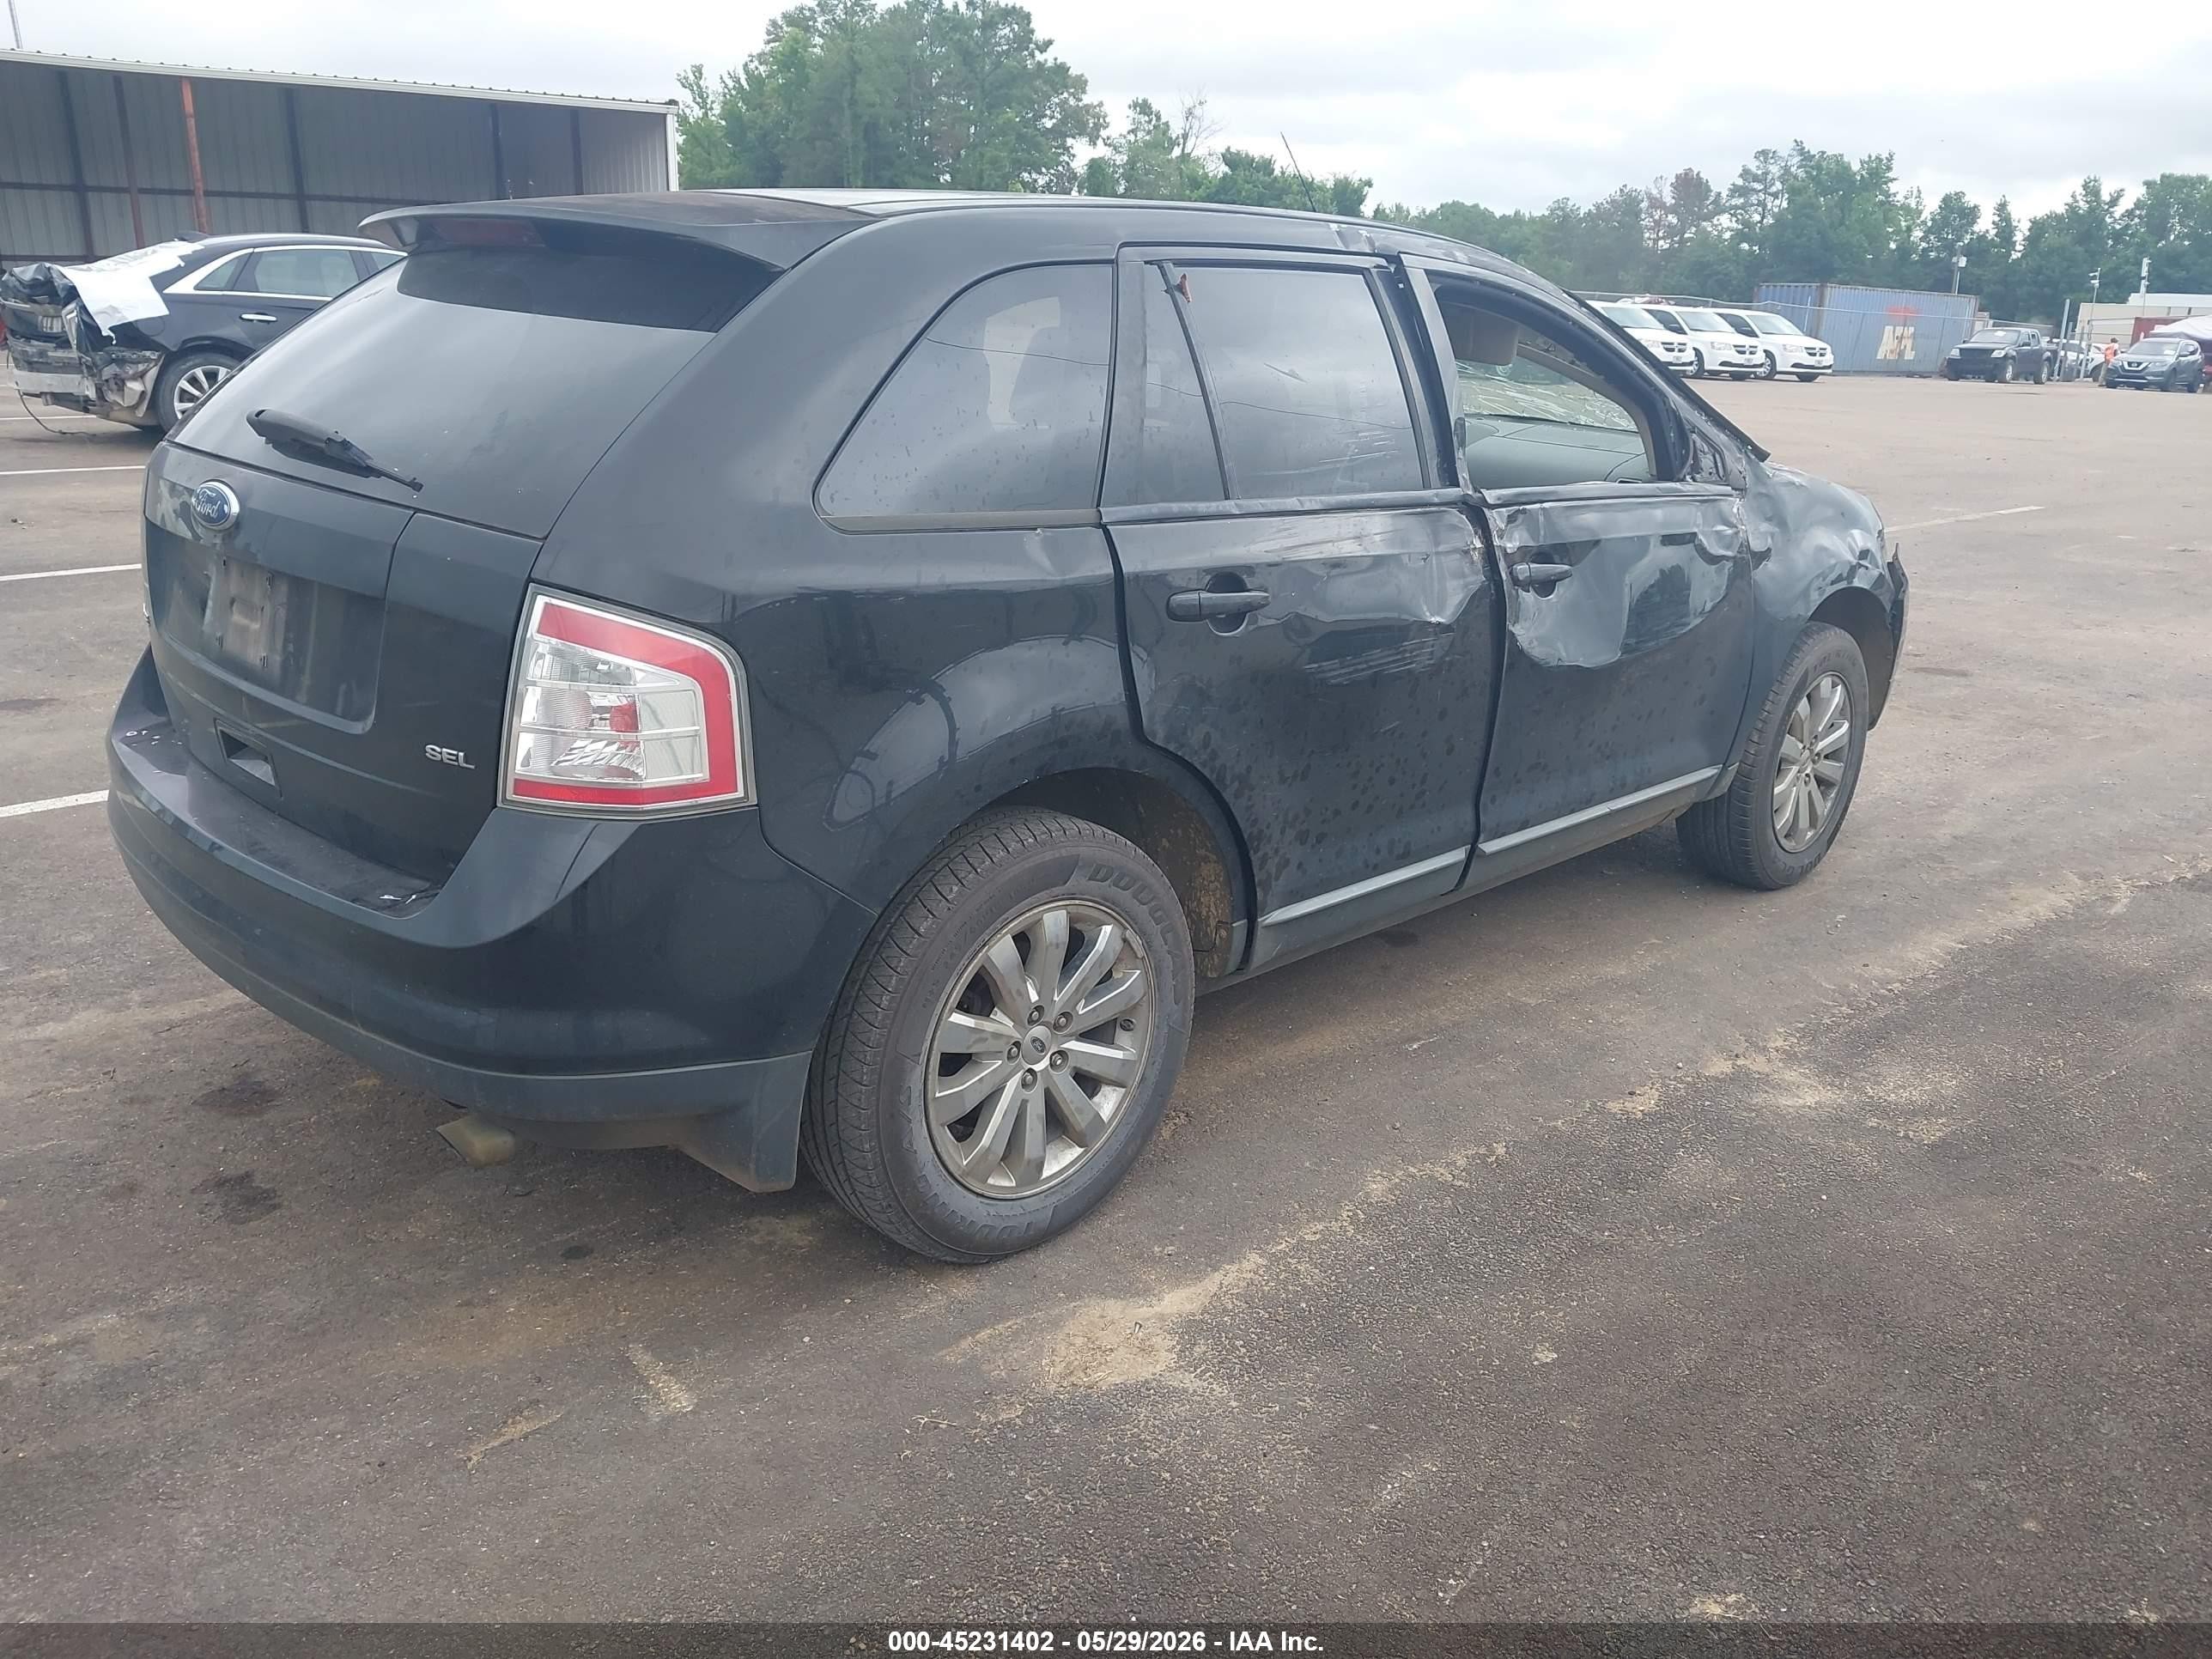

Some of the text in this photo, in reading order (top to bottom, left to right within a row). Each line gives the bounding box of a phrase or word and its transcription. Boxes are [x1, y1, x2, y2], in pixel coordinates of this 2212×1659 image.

[1875, 325, 1916, 360] APL
[191, 488, 222, 519] Ford
[424, 744, 475, 769] SEL
